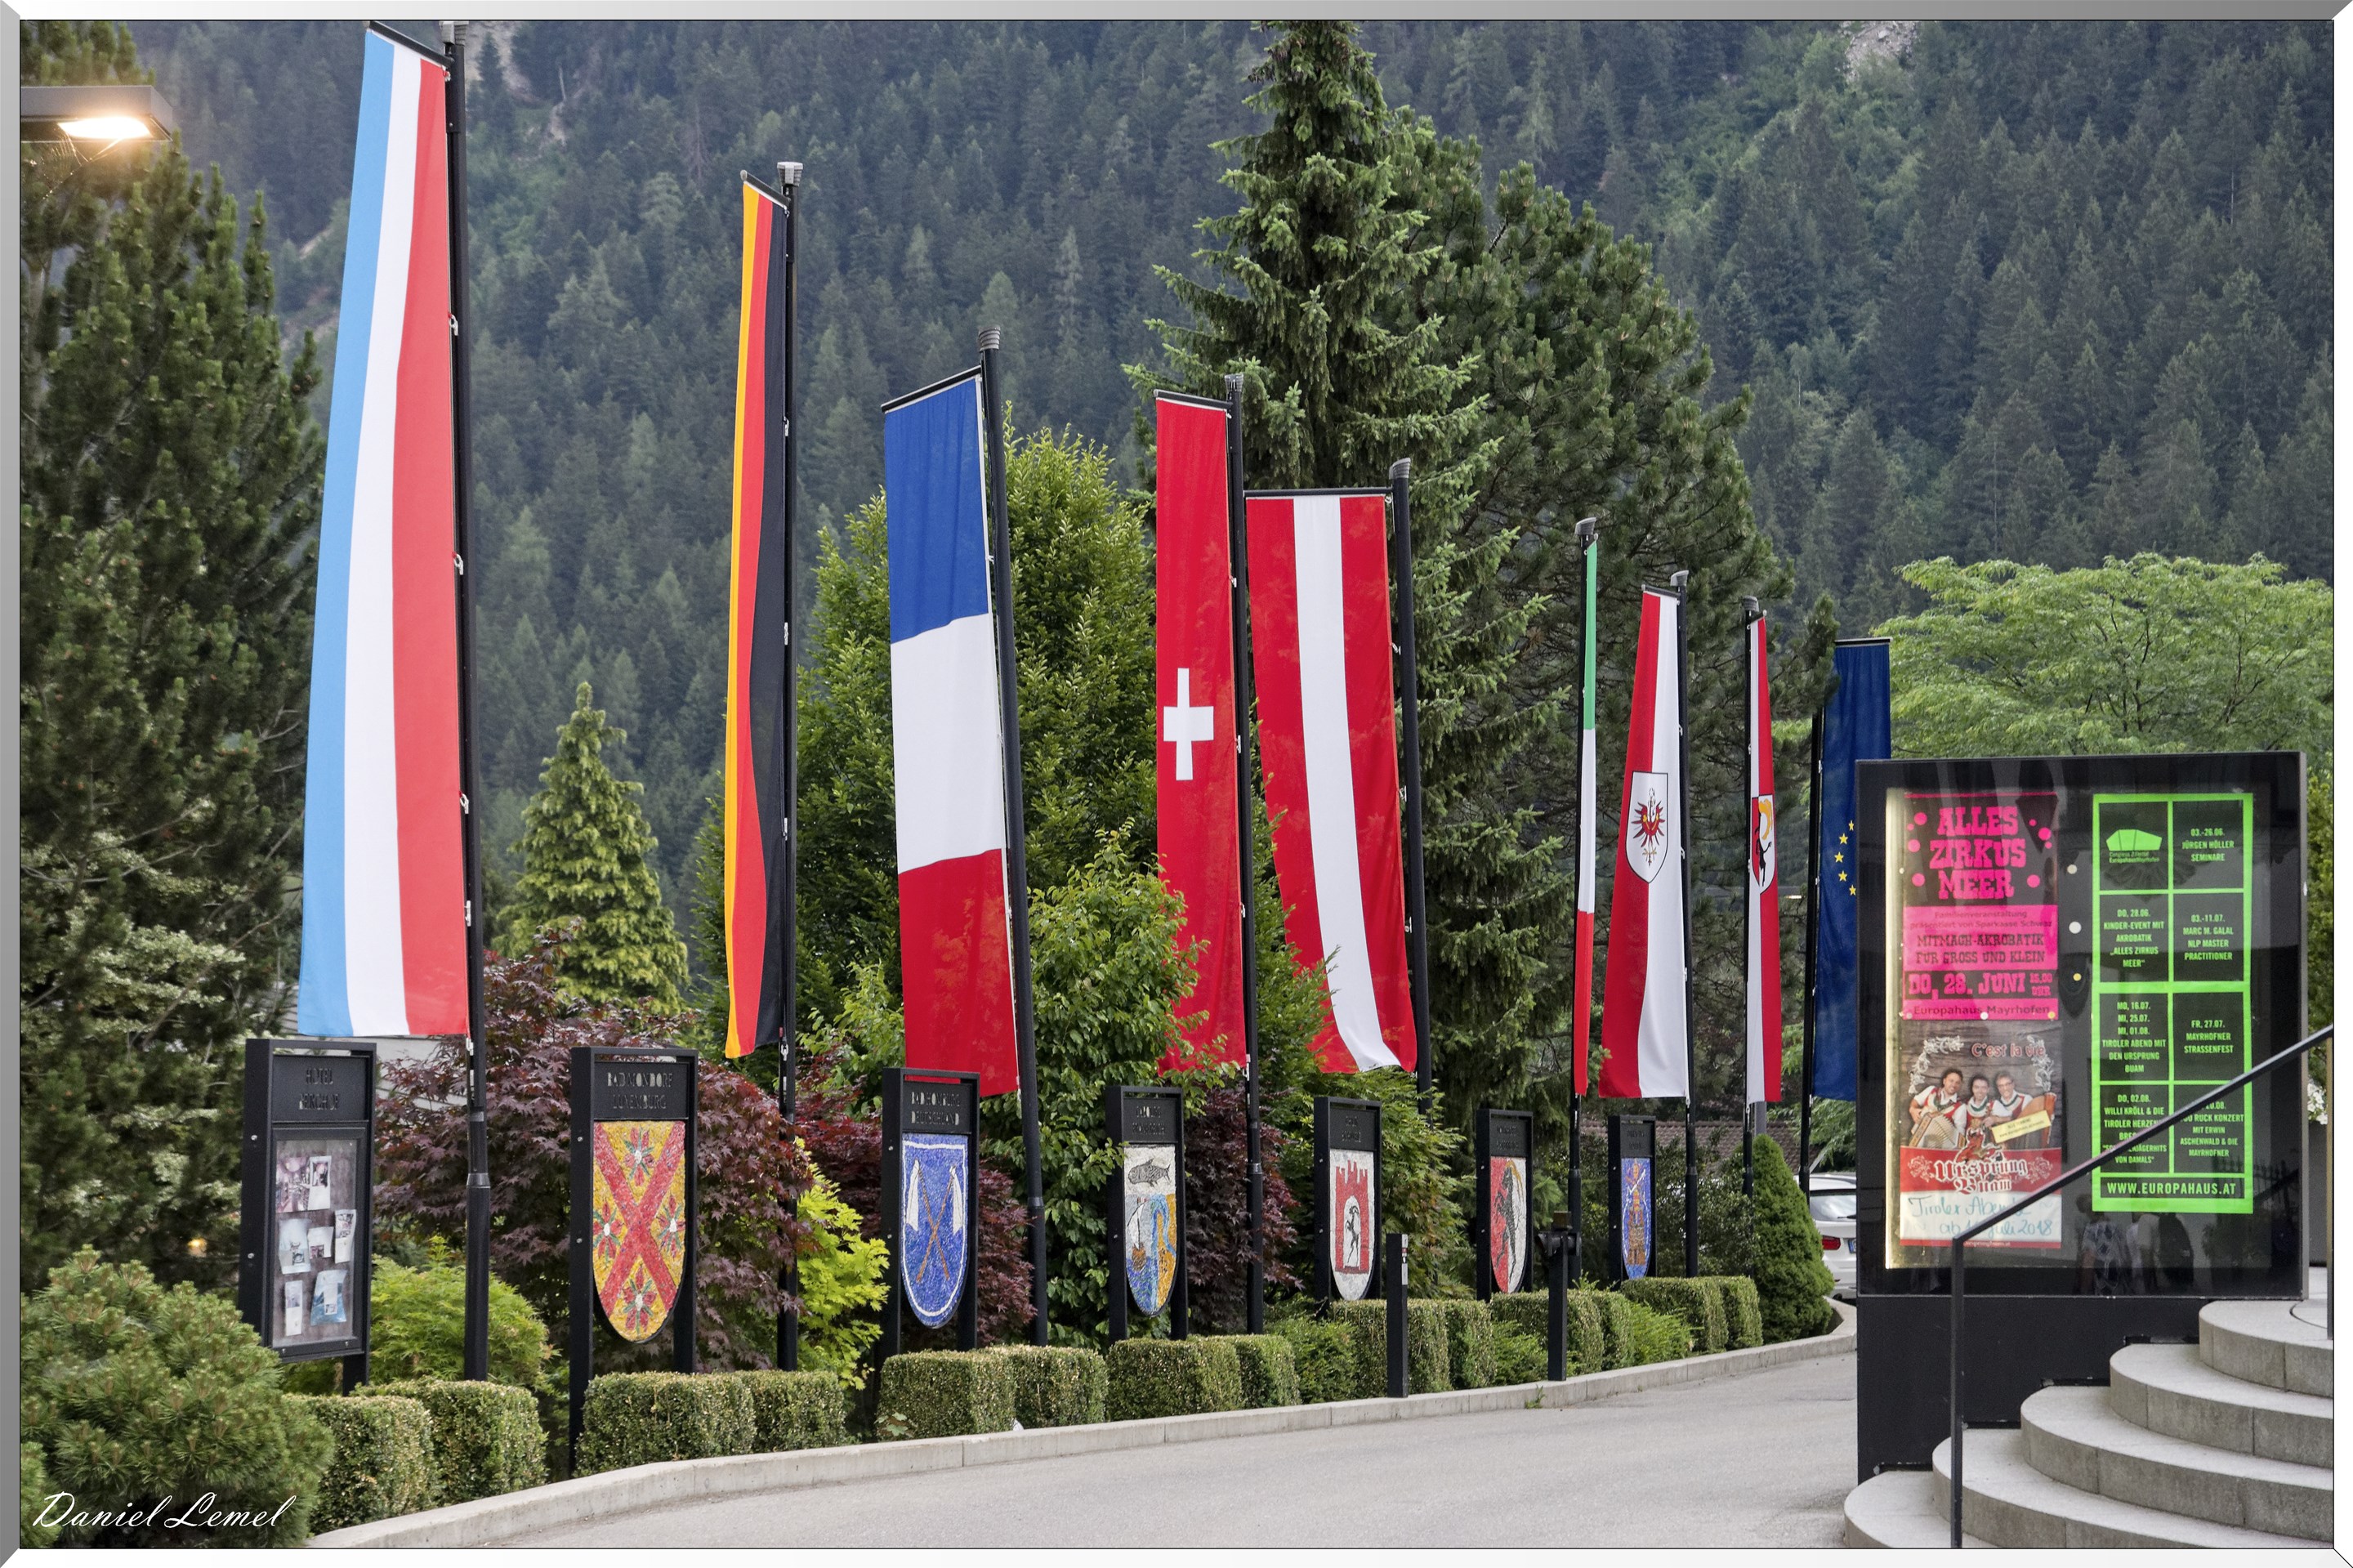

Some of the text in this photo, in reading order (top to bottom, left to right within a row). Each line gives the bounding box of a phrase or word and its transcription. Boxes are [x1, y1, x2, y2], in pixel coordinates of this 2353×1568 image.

[1937, 806, 2018, 837] ALLES
[2182, 839, 2235, 849] JÜRGEN HÖLLER
[1929, 838, 2026, 869] ZIRKUS
[2190, 853, 2225, 862] SEMINARE
[1938, 869, 2015, 900] MEER
[2117, 909, 2129, 918] DO,
[2190, 914, 2226, 922] 03.-11.07.
[2103, 921, 2164, 930] KINDER-EVENT MIT
[2183, 927, 2234, 936] MARC M. GALAL
[2115, 934, 2152, 942] AKROBATIK
[2187, 939, 2229, 948] NLP MASTER
[2134, 946, 2159, 955] ZIRKUS
[1943, 951, 1978, 963] GROSS
[1982, 951, 2006, 963] UND
[2010, 950, 2045, 963] KLEIN
[2184, 952, 2233, 960] PRACTITIONER
[1908, 972, 2025, 999] DO, 28. JUNI
[1913, 1004, 2050, 1016] Europahaus Mayrhofen
[2117, 1002, 2151, 1011] MO, 16.07.
[2118, 1014, 2150, 1023] MI, 25.07.
[2190, 1020, 2226, 1029] FR, 27.07.
[2118, 1027, 2150, 1035] MI, 01.08.
[2186, 1032, 2231, 1040] MAYRHOFNER
[2102, 1039, 2166, 1048] TIROLER ABEND MIT
[2010, 1043, 2022, 1057] la
[2025, 1043, 2045, 1057] vie
[2184, 1045, 2234, 1053] STRASSENFEST
[2109, 1052, 2160, 1060] DEN URSPRUNG
[2124, 1065, 2144, 1073] BUAM
[607, 1072, 672, 1088] BAD MONDORF
[613, 1095, 667, 1110] LUXEMBURG
[2117, 1094, 2150, 1103] DO, 02.08.
[2104, 1106, 2165, 1115] WILLI KRÖLL & DIE
[911, 1111, 960, 1126] DEUTSCHLAND
[2194, 1114, 2212, 1122] RUCK
[2213, 1114, 2244, 1122] KONZERT
[2104, 1119, 2159, 1128] TIROLER HERZE
[2193, 1126, 2226, 1134] MIT ERWIN
[2180, 1137, 2239, 1146] ASCHENWALD & DIE
[2188, 1149, 2230, 1157] MAYRHOFNER
[2114, 1155, 2128, 1164] VON
[1934, 1158, 2029, 1182] Ursprung
[1953, 1177, 2011, 1195] Buam
[2106, 1182, 2236, 1195] WWW.EUROPAHAUS.AT
[1909, 1195, 2032, 1217] Tiroler Aben
[1939, 1220, 1962, 1236] ab
[2016, 1220, 2053, 1237] 2018
